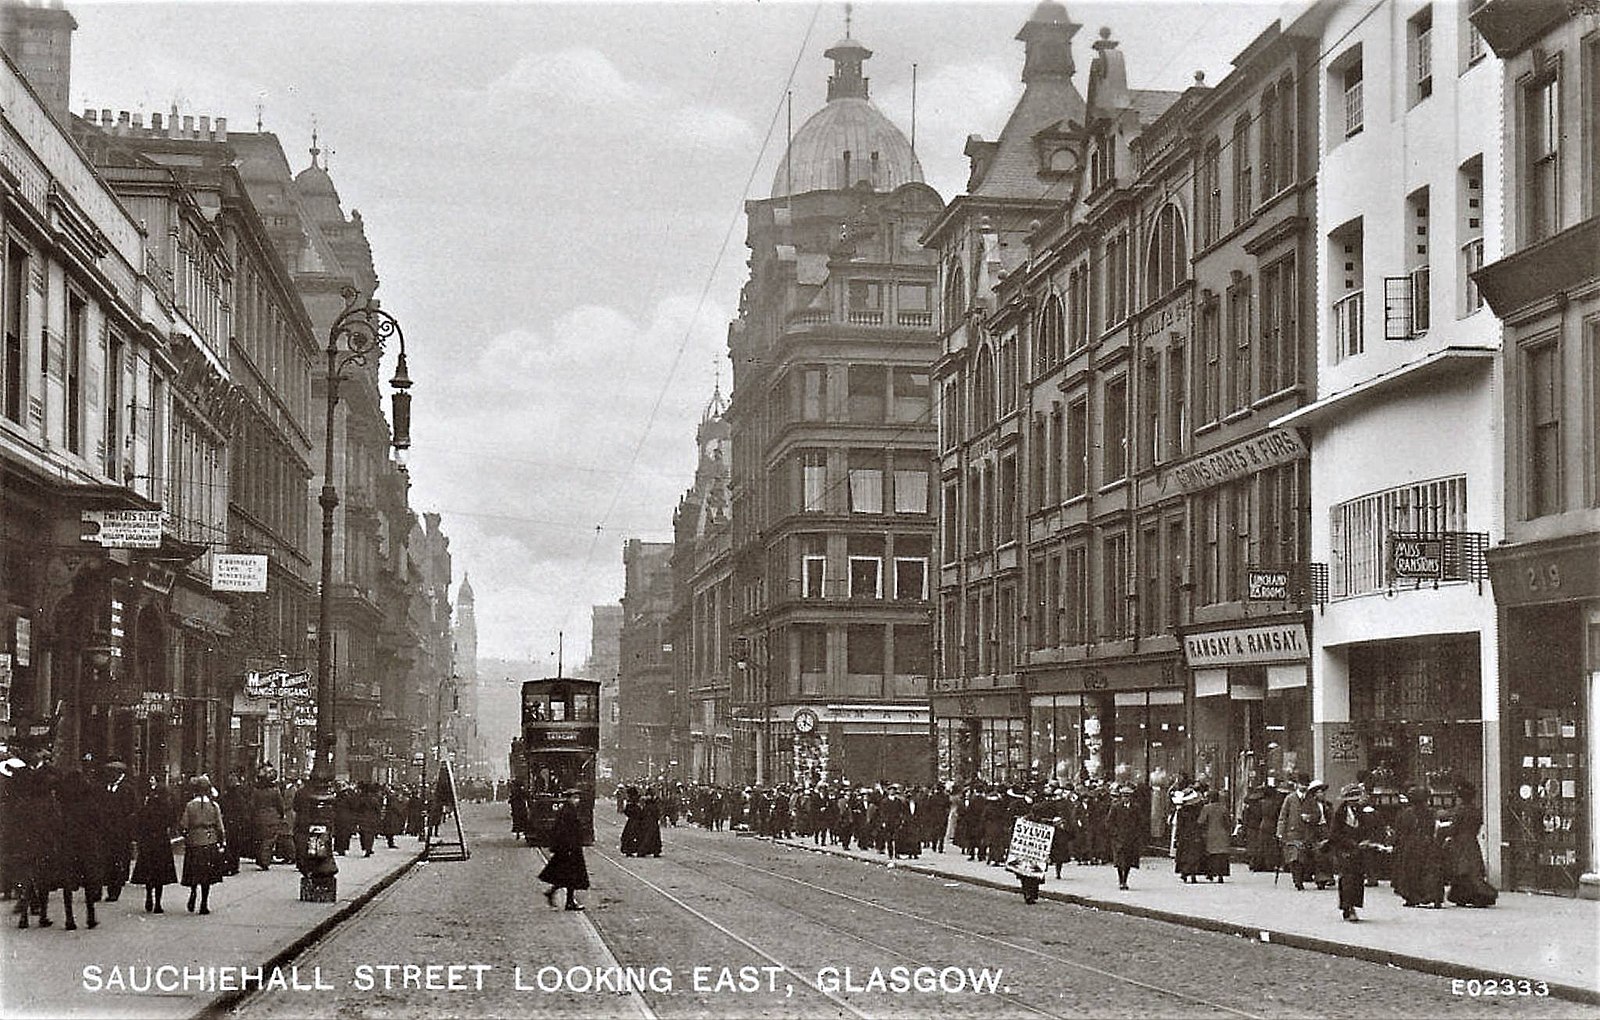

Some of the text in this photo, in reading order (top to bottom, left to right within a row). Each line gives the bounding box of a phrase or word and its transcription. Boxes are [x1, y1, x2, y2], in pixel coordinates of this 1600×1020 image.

[1396, 542, 1421, 557] MISS
[1527, 565, 1560, 591] 219
[1188, 637, 1231, 657] RAMSAY
[1234, 635, 1244, 655] &
[1016, 824, 1051, 839] SYLVIA
